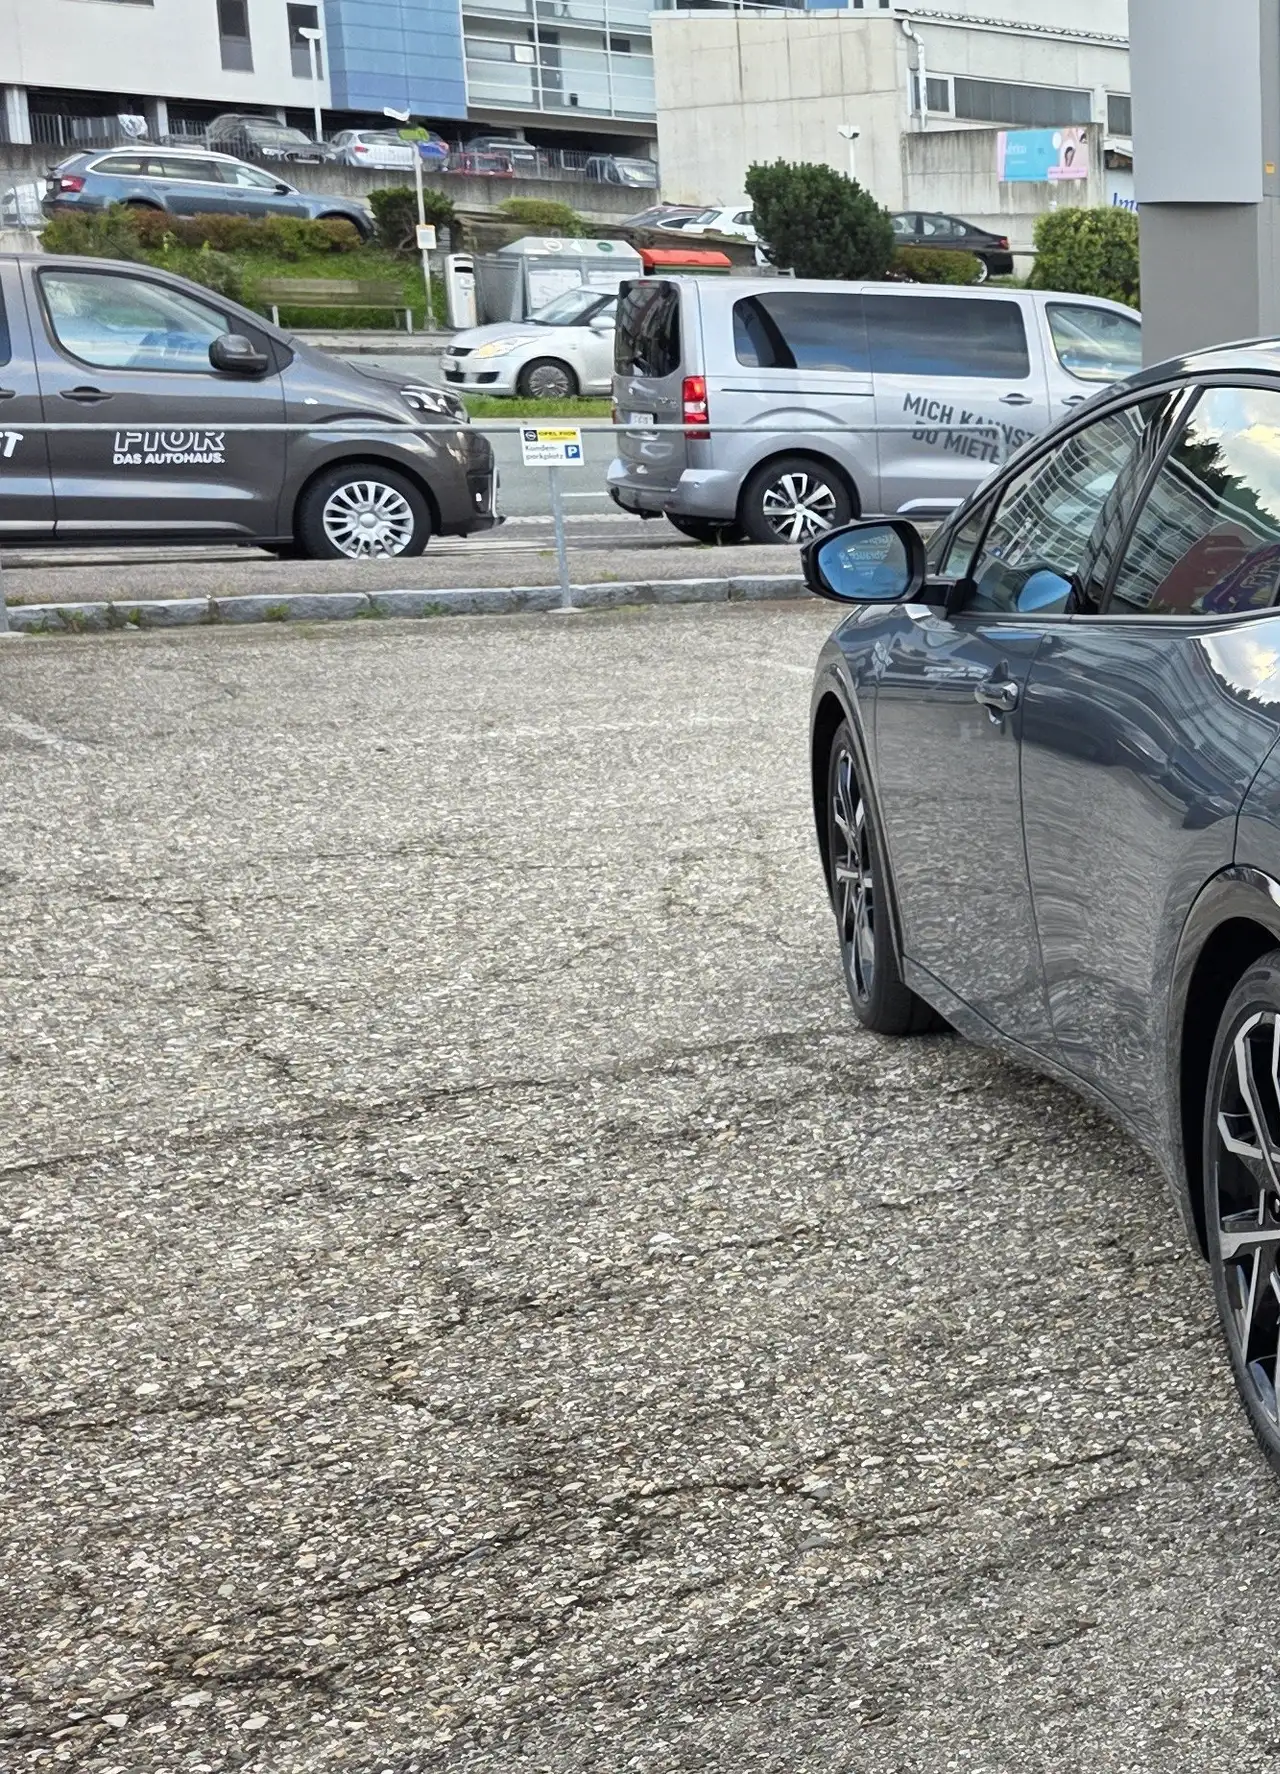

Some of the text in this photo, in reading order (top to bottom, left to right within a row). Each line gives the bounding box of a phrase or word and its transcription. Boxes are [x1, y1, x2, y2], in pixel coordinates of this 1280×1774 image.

[903, 392, 954, 424] MICH
[114, 431, 225, 451] FIOR
[943, 429, 1009, 466] MIETE
[113, 453, 225, 465] DAS AUTOHAUS.
